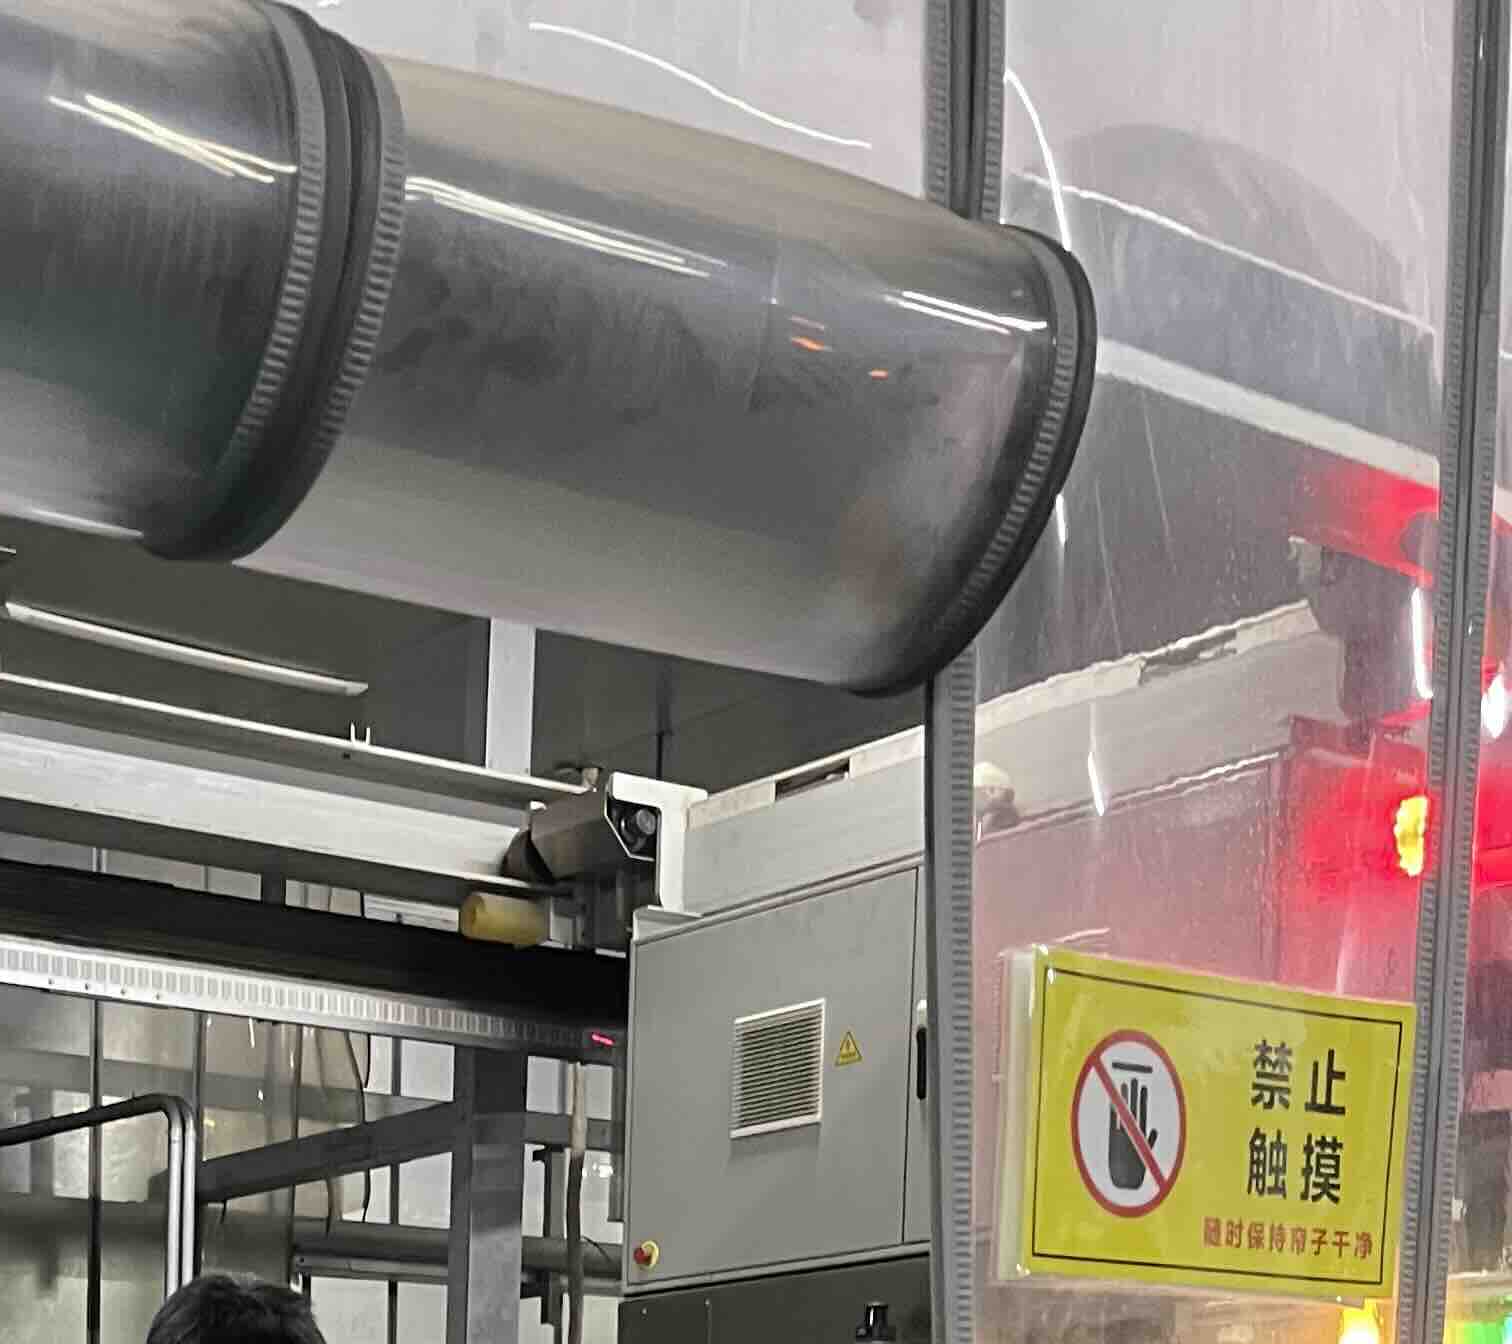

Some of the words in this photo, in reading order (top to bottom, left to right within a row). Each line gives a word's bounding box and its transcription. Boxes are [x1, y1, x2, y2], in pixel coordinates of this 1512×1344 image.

[1250, 1039, 1346, 1116] 禁止
[1247, 1127, 1344, 1205] 触摸
[1203, 1215, 1374, 1260] 随时保持帘子干净
